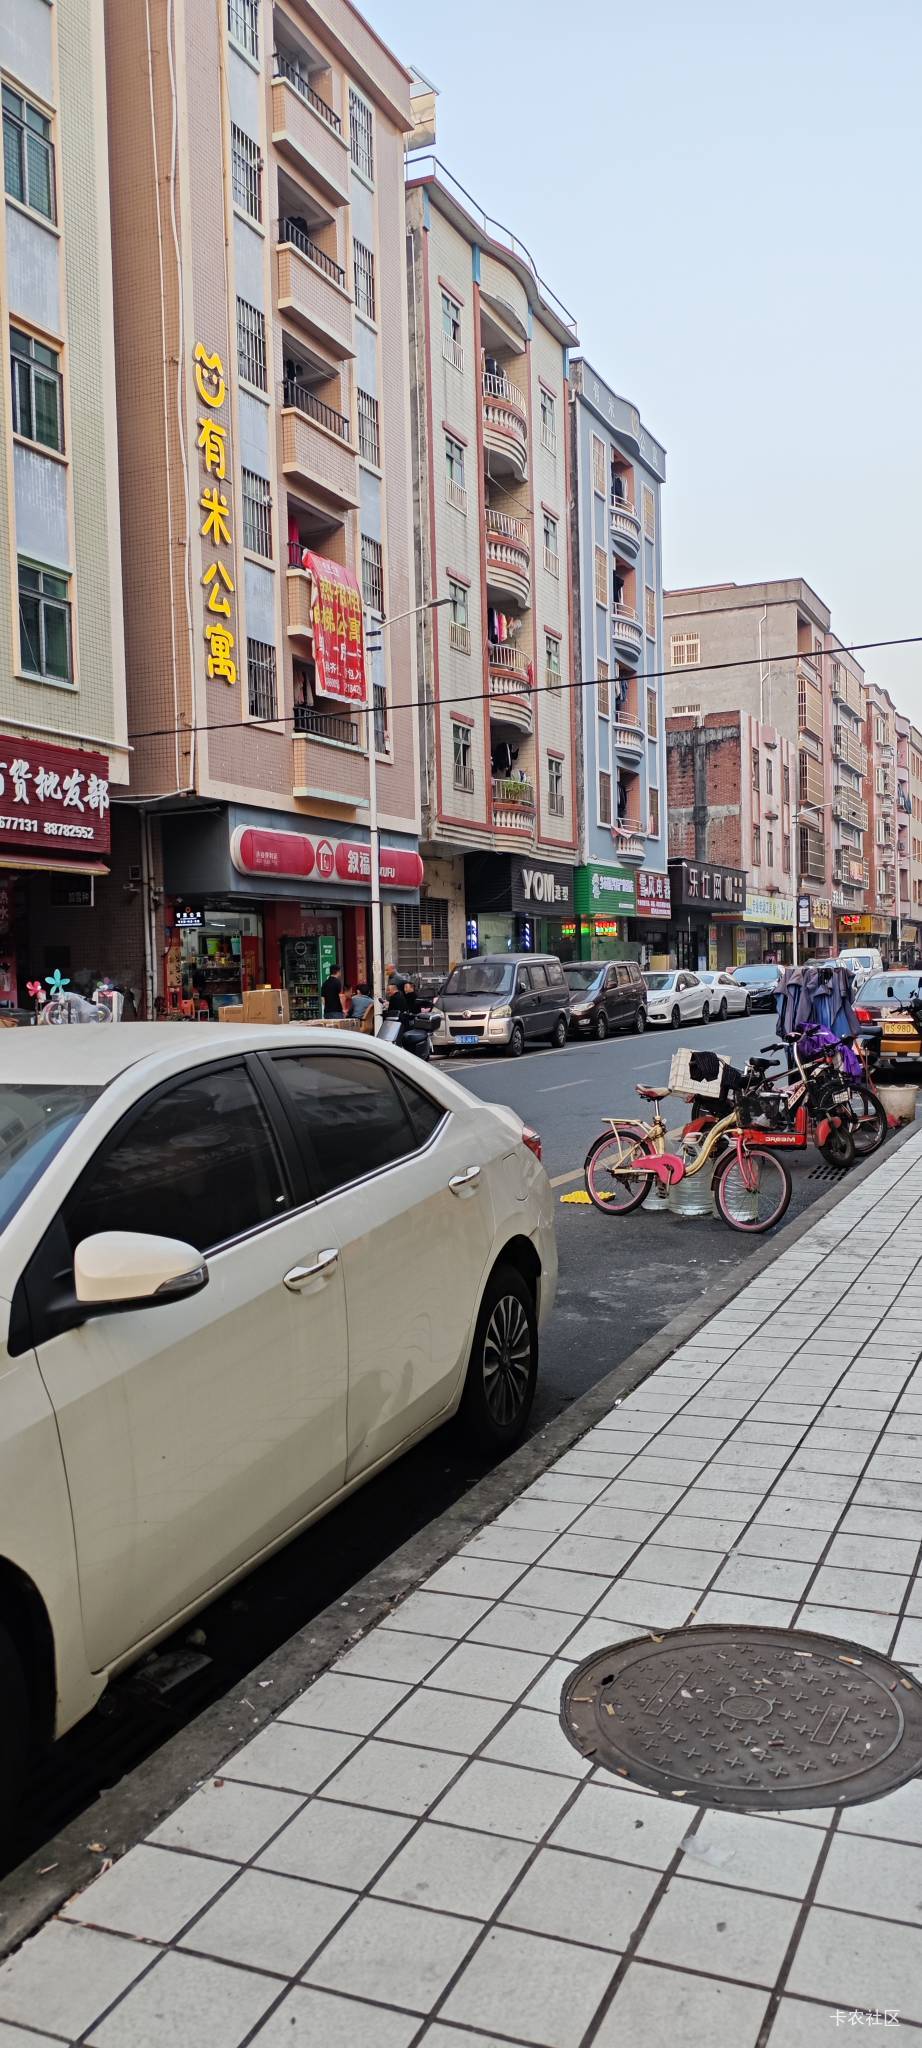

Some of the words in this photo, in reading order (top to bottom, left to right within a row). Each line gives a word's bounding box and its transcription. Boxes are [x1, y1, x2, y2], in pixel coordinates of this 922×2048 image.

[197, 417, 237, 685] 有米公寓
[43, 822, 95, 839] 88782552
[347, 849, 371, 875] 叙福
[522, 869, 555, 902] YOM
[554, 884, 569, 901] 造型
